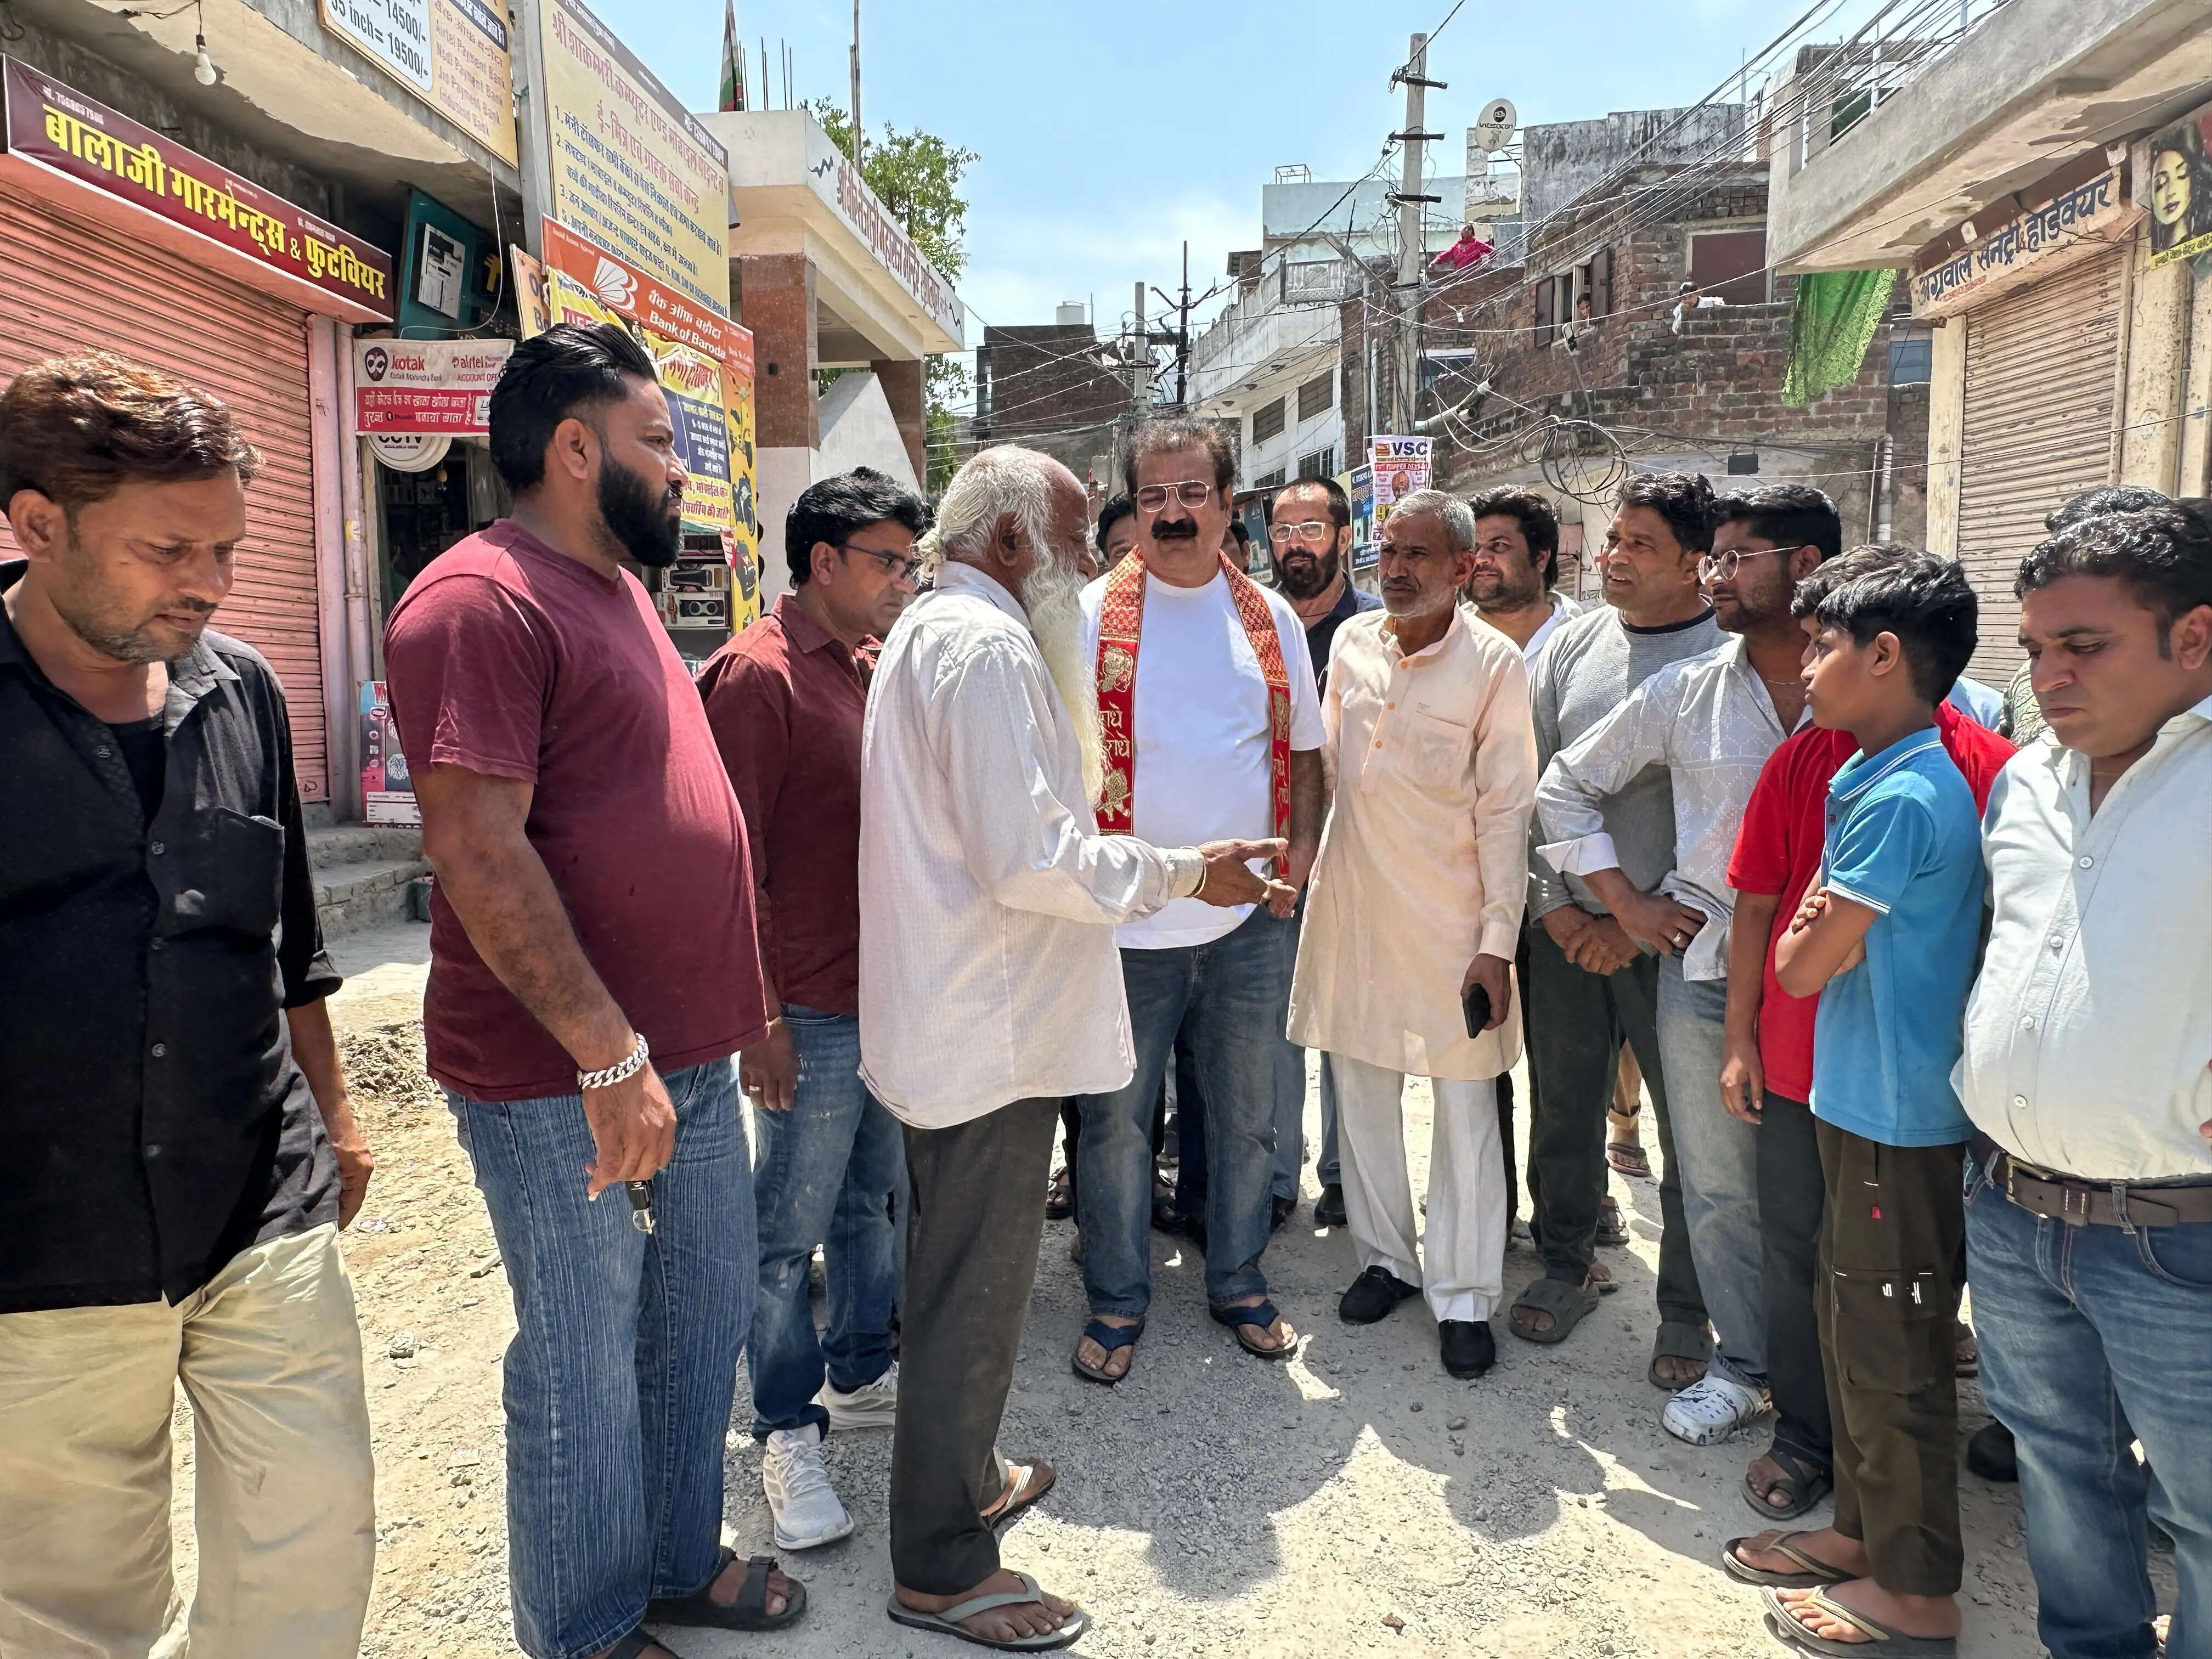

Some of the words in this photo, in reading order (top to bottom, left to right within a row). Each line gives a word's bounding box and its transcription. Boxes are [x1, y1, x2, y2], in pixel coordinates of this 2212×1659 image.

[552, 10, 567, 48] श्री
[387, 32, 428, 79] 19500/-
[42, 103, 166, 197] बालाजी
[170, 167, 287, 257] गारमेन्ट्स
[290, 237, 302, 261] &
[304, 234, 386, 300] फुटवियर
[1919, 250, 1974, 306] अग्रवाल
[650, 309, 679, 336] Bank
[679, 329, 691, 341] of
[691, 331, 726, 360] Baroda
[391, 354, 425, 371] kotak
[460, 354, 483, 369] airtel
[1391, 442, 1428, 456] VSC
